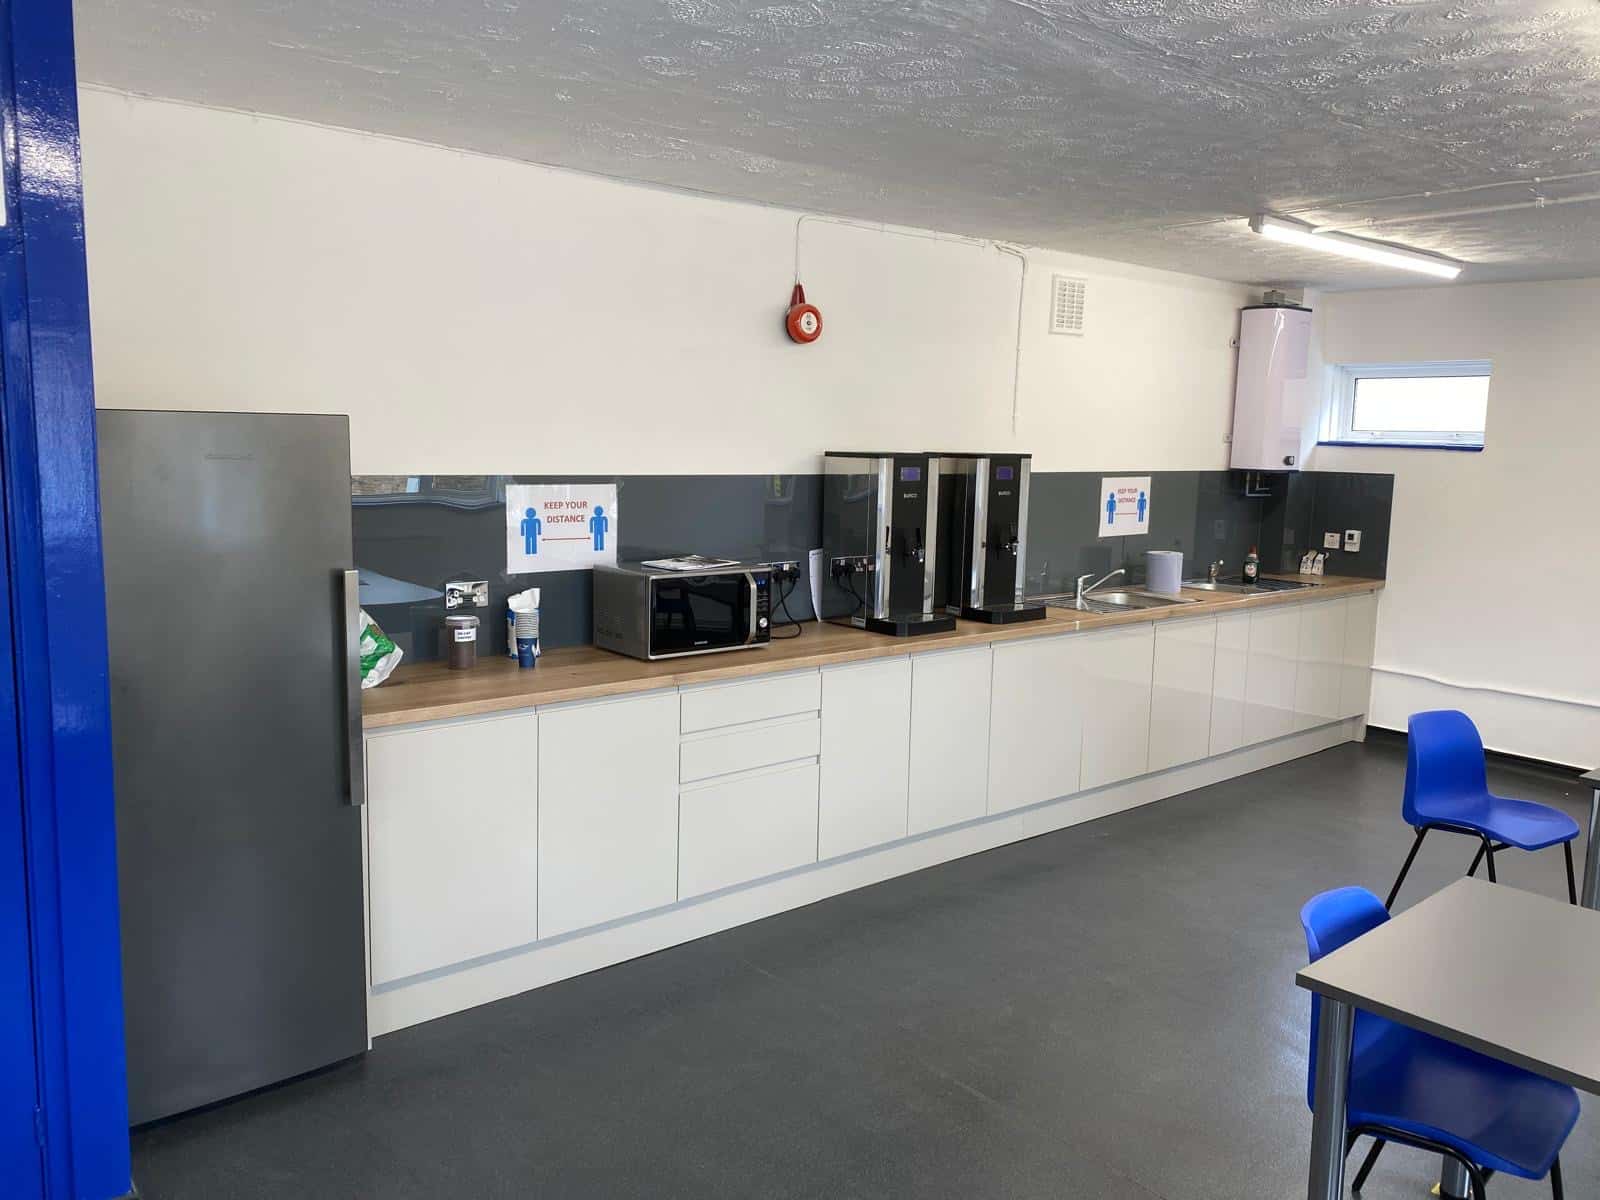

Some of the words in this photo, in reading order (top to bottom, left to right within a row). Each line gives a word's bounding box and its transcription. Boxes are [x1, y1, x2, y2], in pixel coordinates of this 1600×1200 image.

[544, 501, 563, 510] KEEP
[565, 500, 588, 509] YOUR
[546, 515, 585, 524] DISTANCE
